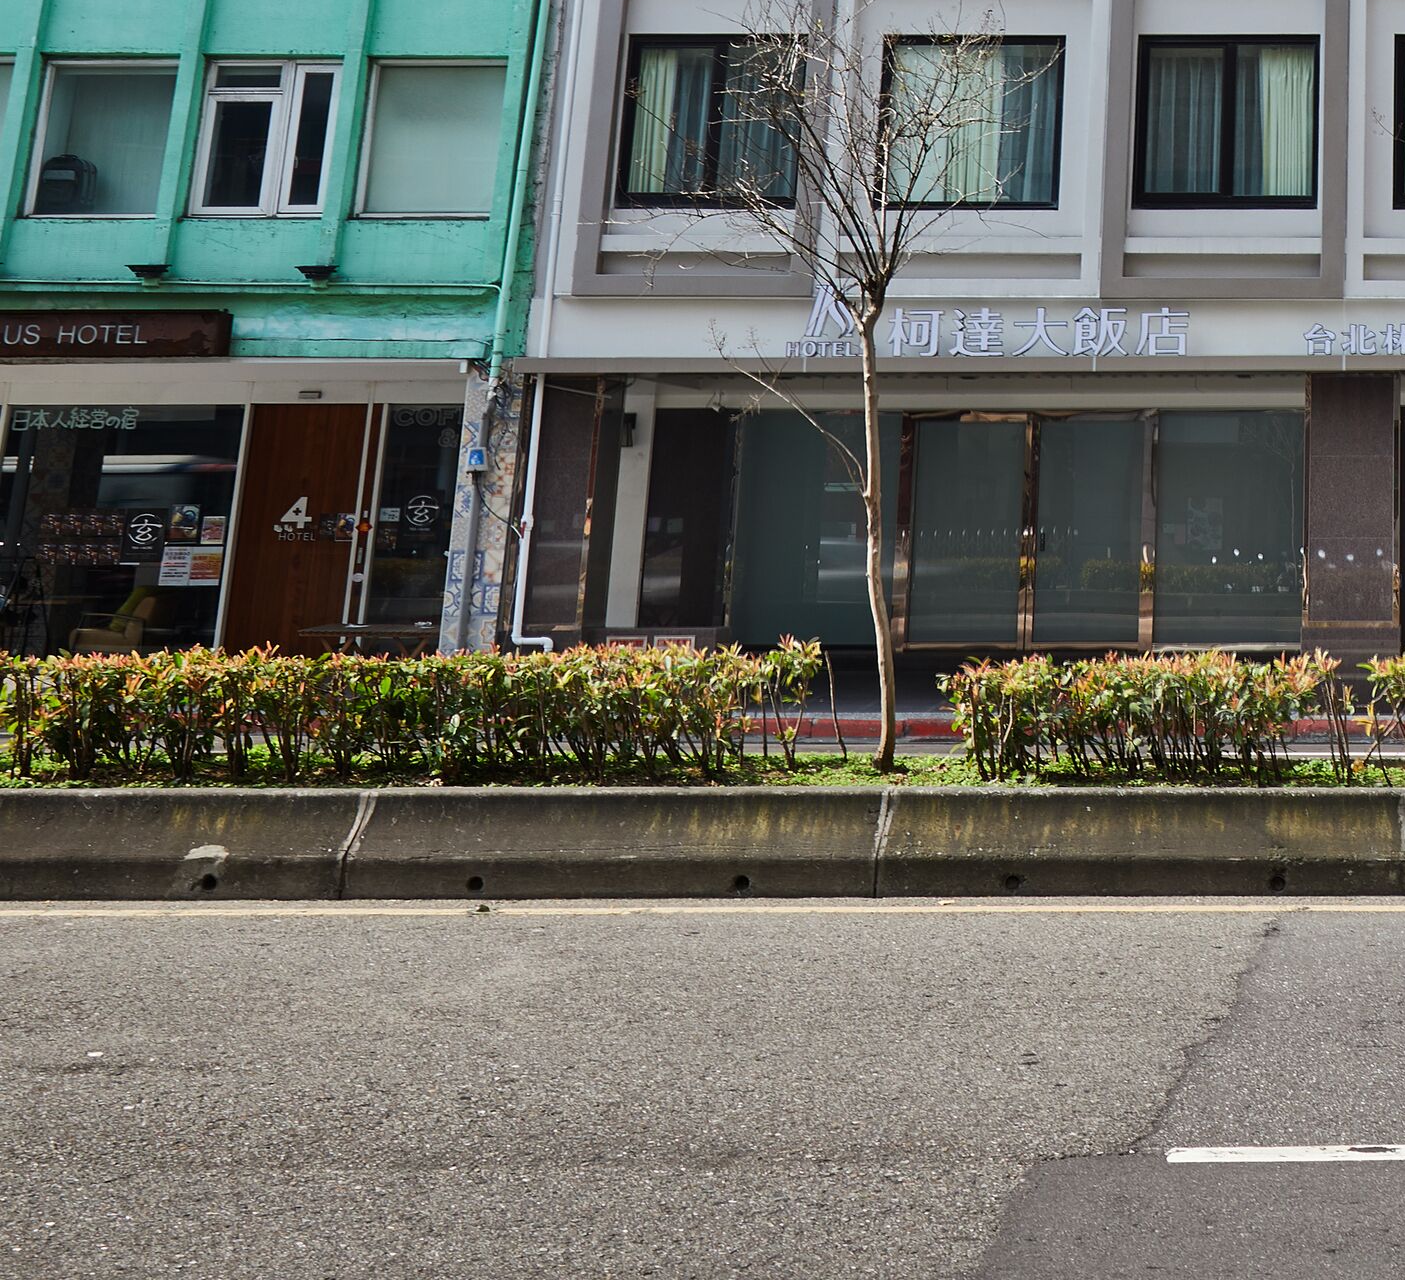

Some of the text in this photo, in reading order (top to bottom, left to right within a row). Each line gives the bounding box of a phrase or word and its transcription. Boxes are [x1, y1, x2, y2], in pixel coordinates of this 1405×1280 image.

[57, 324, 148, 345] HOTEL
[888, 306, 1190, 358] 柯達大飯店
[785, 340, 865, 358] HOTEL
[11, 406, 140, 432] 日本人経営の宿
[280, 496, 313, 529] 4
[278, 532, 316, 542] HOTEL
